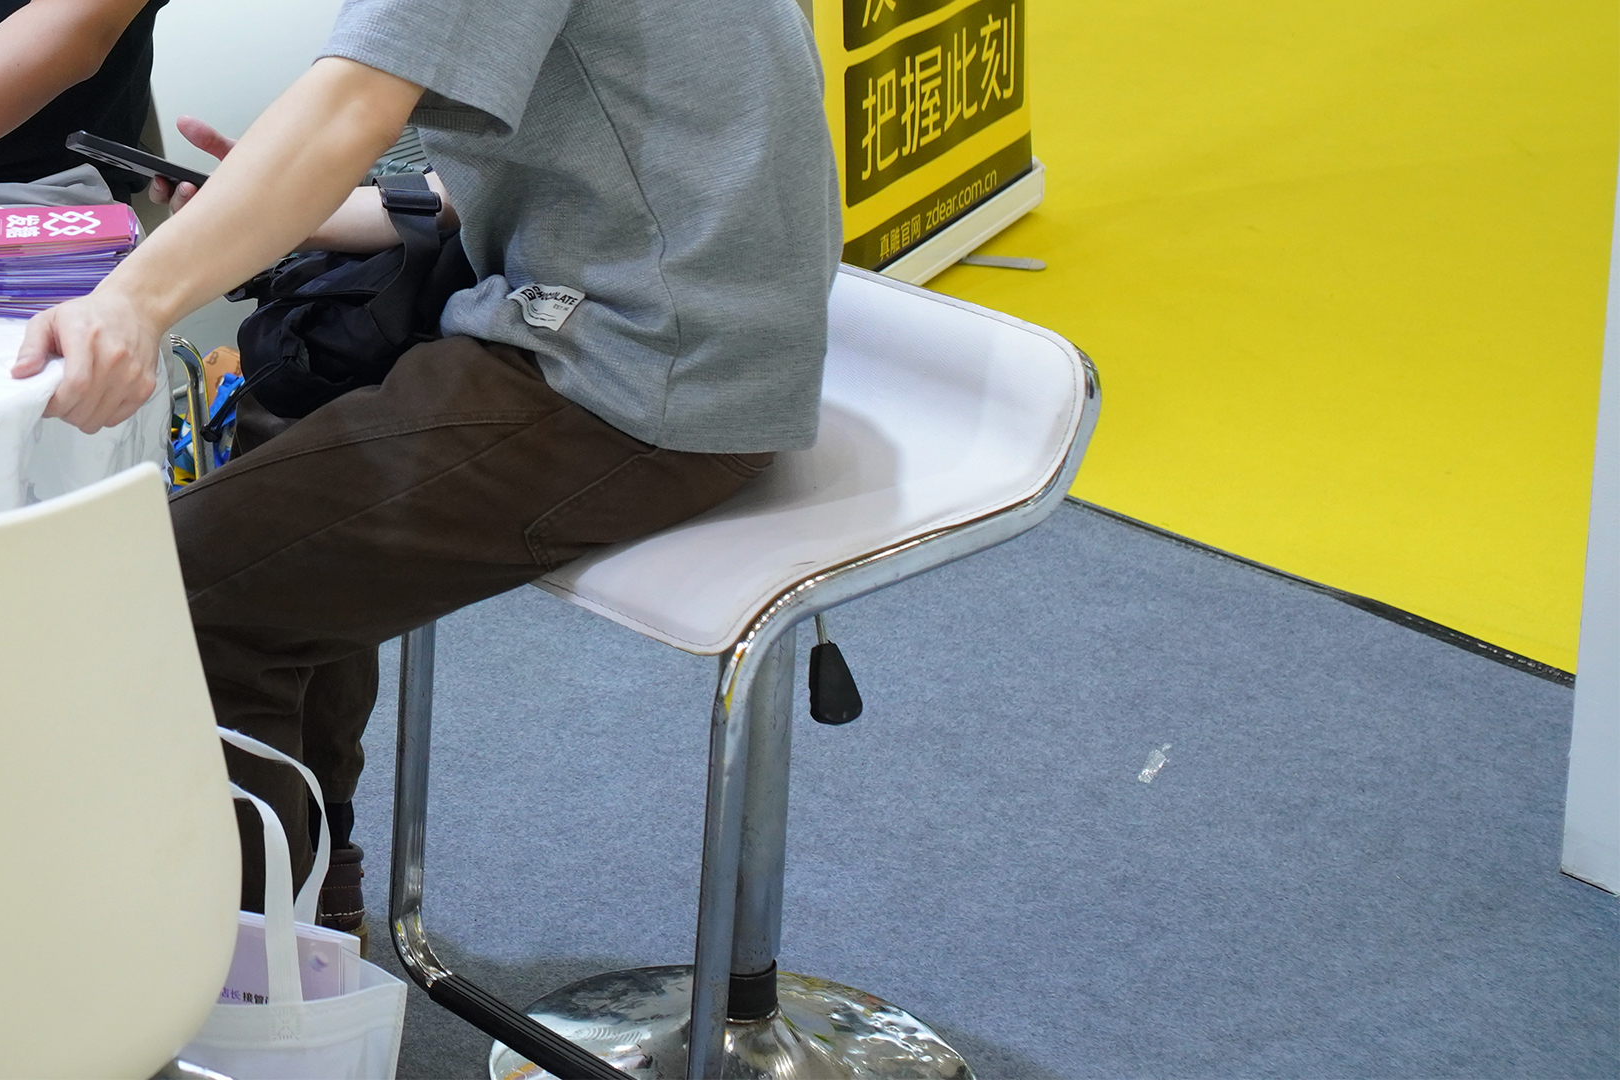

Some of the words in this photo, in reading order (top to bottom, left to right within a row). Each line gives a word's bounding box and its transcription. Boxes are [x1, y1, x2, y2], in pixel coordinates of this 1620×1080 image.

[861, 3, 1017, 181] 把握此刻
[925, 169, 998, 231] zdear.com.cn
